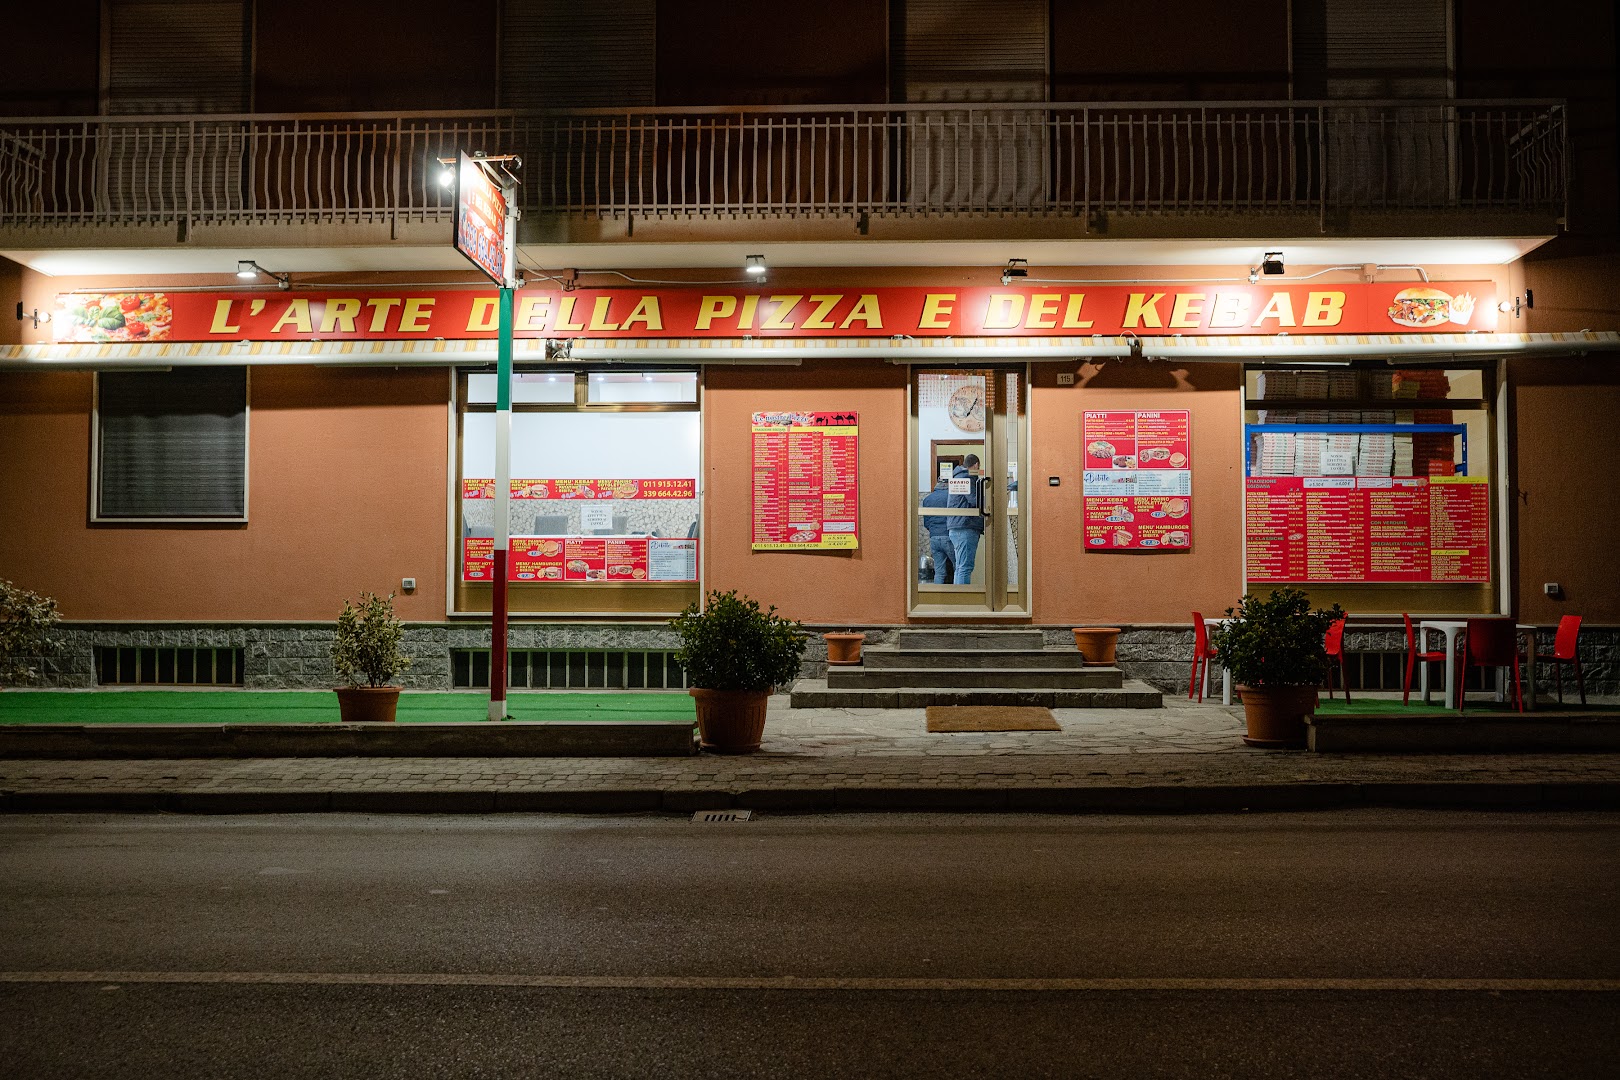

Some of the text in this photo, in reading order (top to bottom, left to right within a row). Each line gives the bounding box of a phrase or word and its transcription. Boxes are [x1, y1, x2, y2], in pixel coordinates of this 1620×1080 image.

[466, 296, 664, 333] DELLA
[694, 294, 884, 331] PIZZA
[918, 293, 957, 330] E
[983, 293, 1094, 331] DEL
[1122, 291, 1347, 328] KEBAB
[1060, 375, 1070, 383] 115
